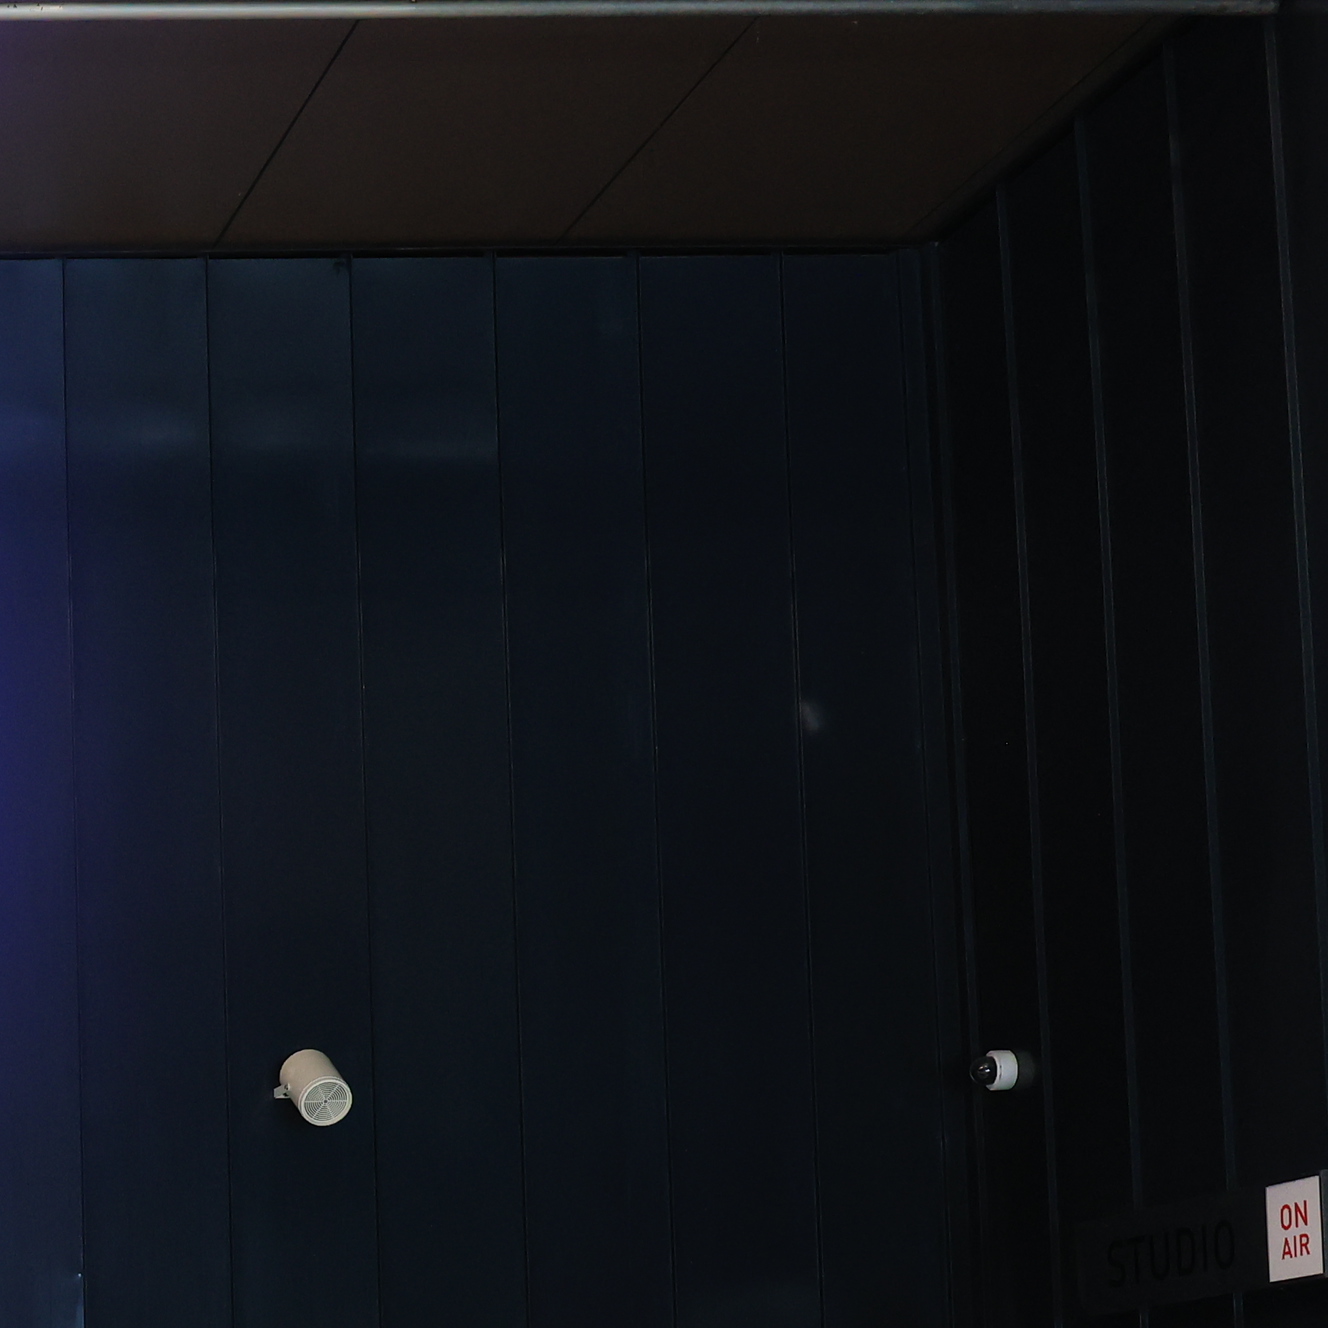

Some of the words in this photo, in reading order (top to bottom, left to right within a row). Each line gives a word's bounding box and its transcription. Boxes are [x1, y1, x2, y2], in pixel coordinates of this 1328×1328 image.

[1280, 1200, 1308, 1230] ON
[1107, 1219, 1235, 1288] STUDIO
[1282, 1233, 1310, 1260] AIR
